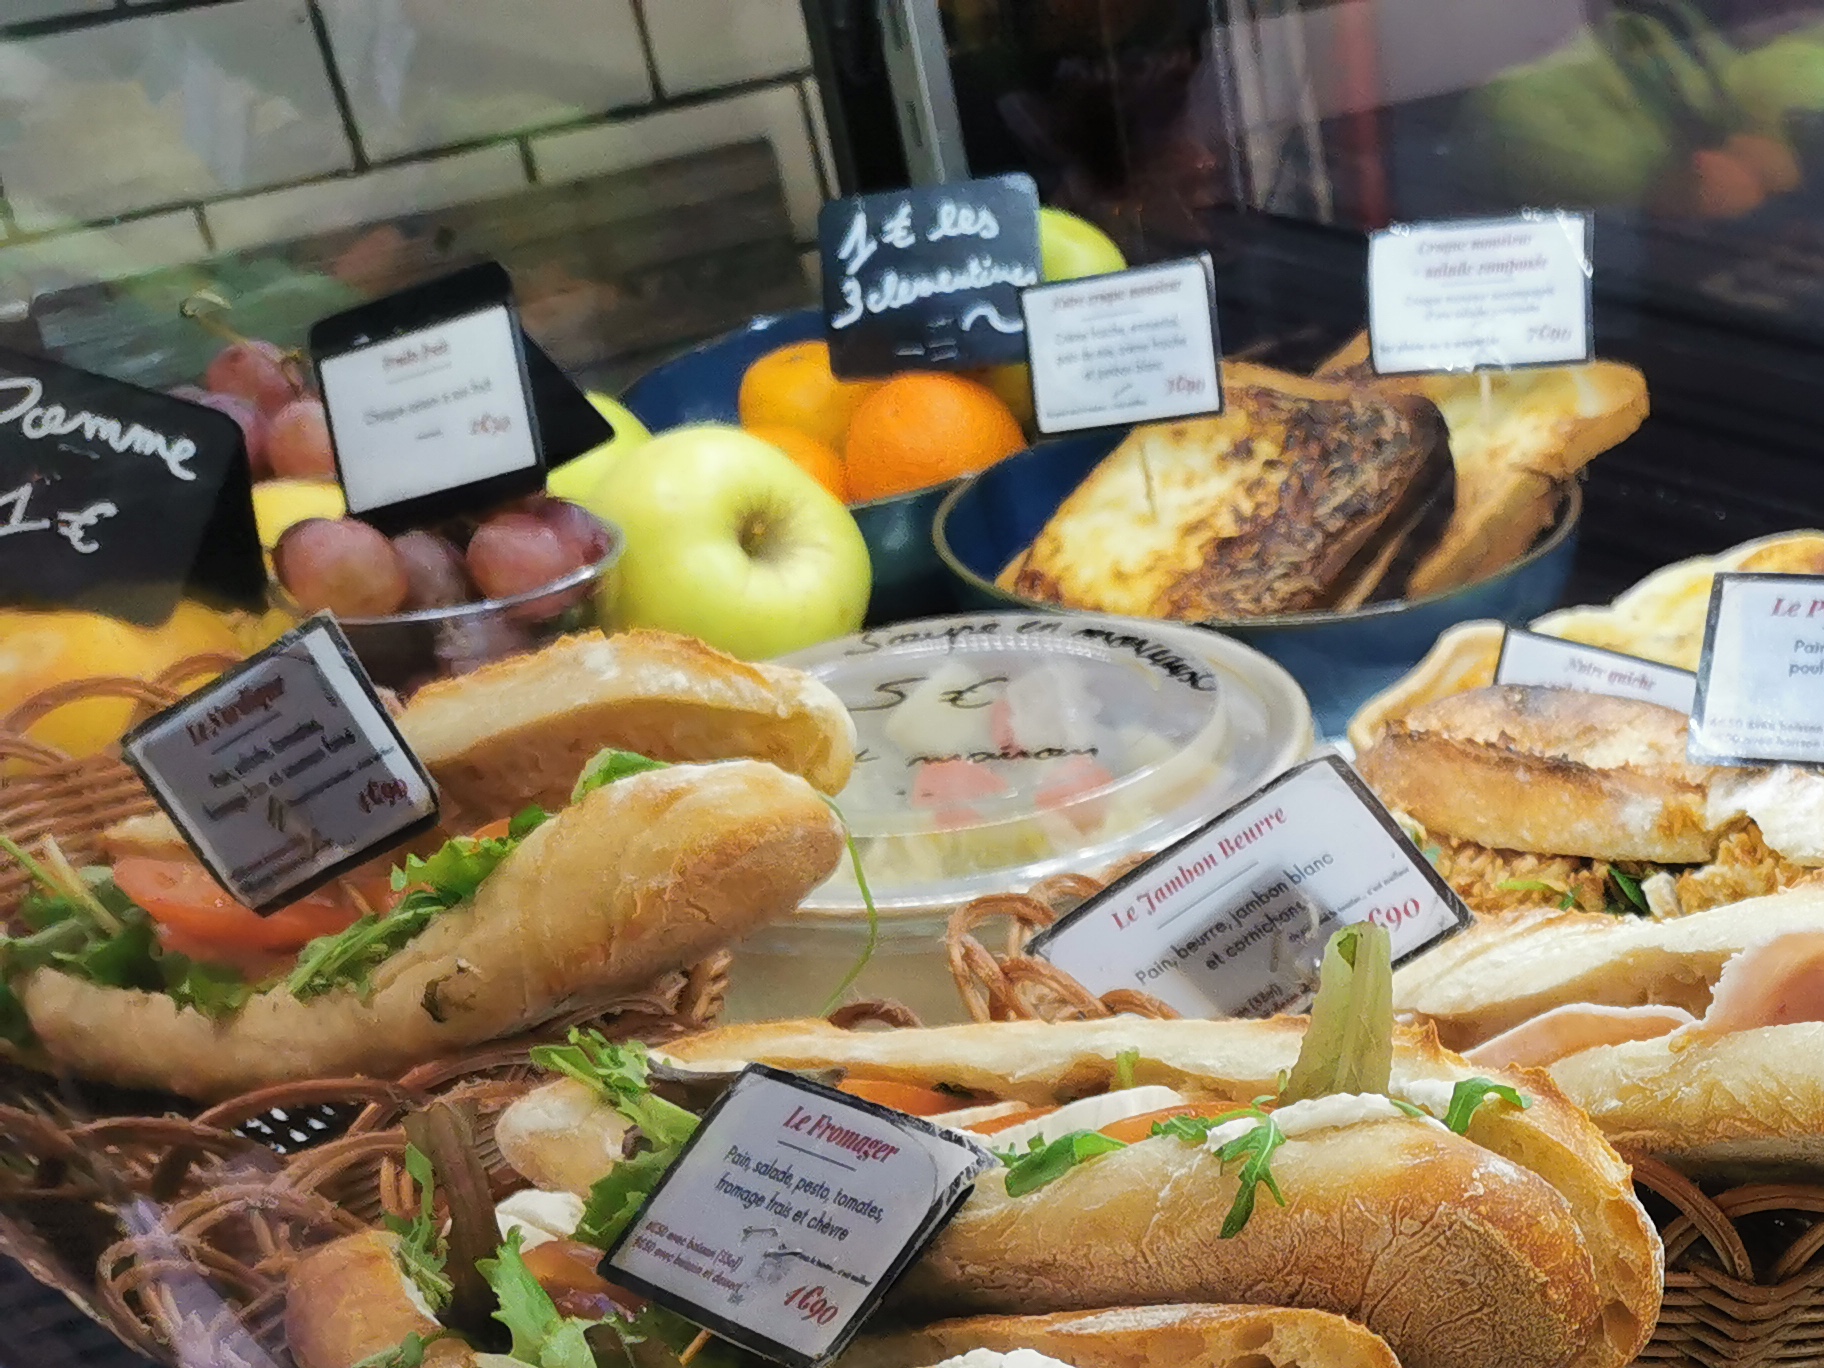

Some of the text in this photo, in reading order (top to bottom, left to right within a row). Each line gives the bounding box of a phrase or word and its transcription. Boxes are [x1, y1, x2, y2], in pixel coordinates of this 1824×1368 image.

[1770, 597, 1801, 618] Le
[1111, 805, 1288, 932] Le Jambon Beurre
[1134, 955, 1178, 986] Pain,
[1170, 920, 1233, 960] beurre,
[1229, 880, 1290, 929] jambon
[1283, 852, 1335, 885] blanc
[1367, 897, 1420, 932] €90
[1206, 950, 1226, 971] et
[782, 1105, 900, 1163] Le Fromager
[715, 1171, 849, 1241] fromage frais et chèvre
[723, 1144, 884, 1224] Pain, salade, pesto, tomates,
